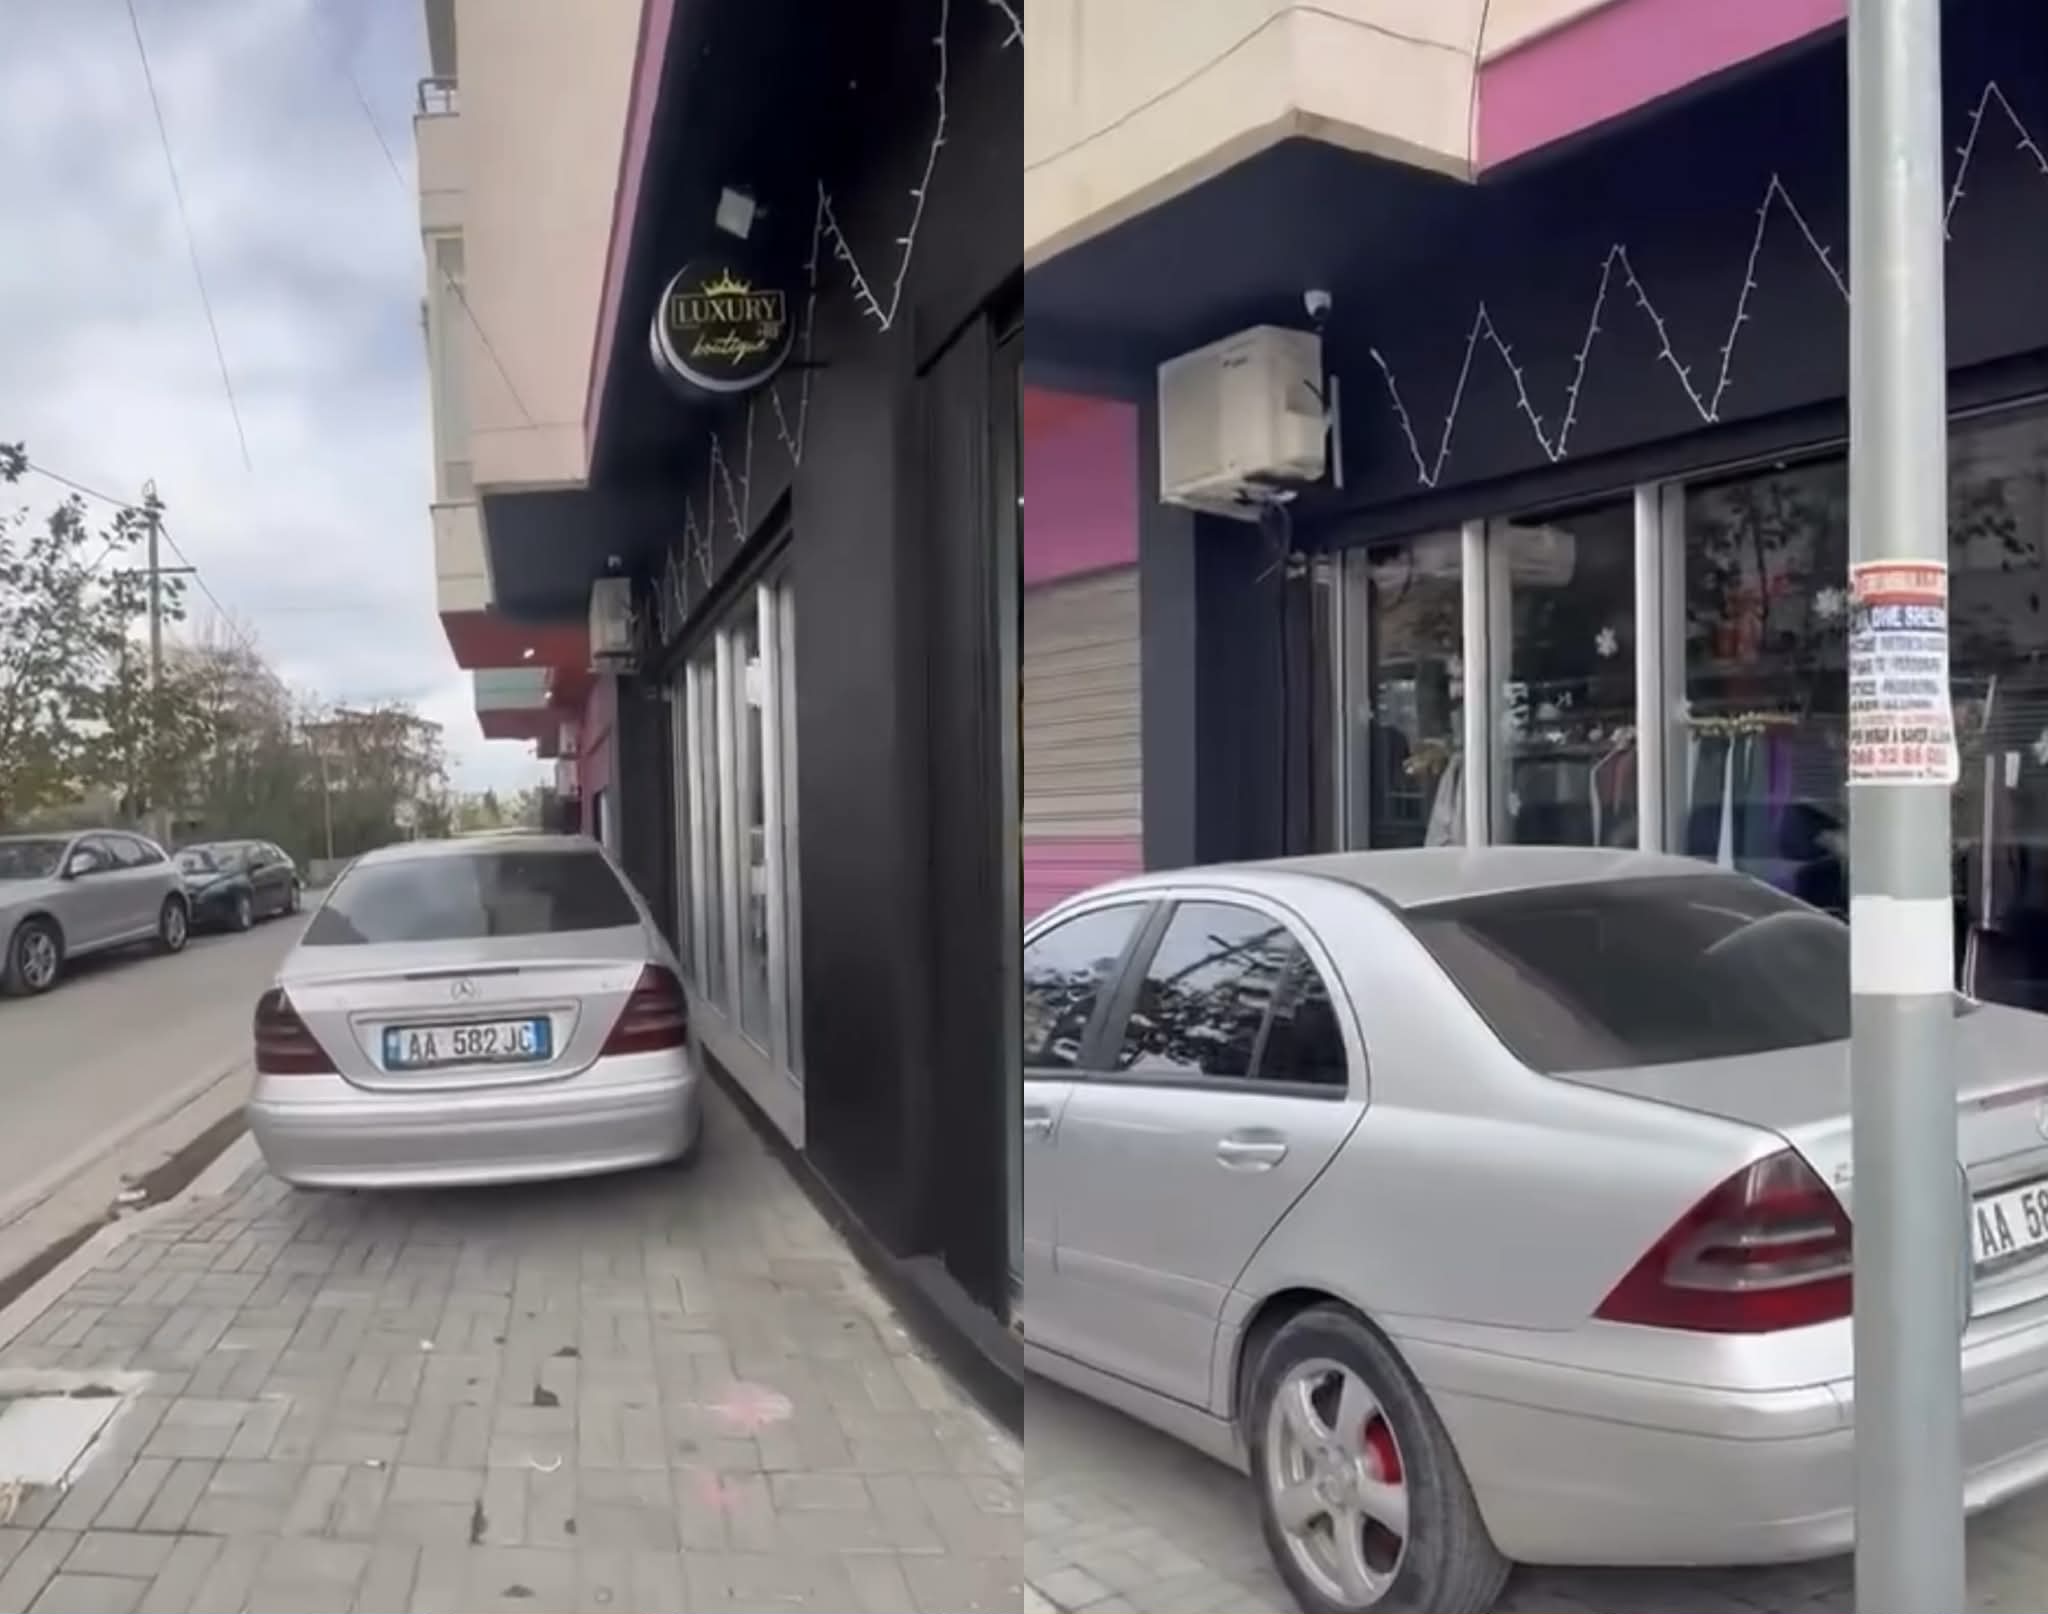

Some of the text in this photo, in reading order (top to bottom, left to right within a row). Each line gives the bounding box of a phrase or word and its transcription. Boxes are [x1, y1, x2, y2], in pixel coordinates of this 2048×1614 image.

[679, 296, 777, 323] LUXURY
[409, 1031, 438, 1060] AA
[453, 1028, 498, 1055] 582
[1976, 1202, 2015, 1257] AA
